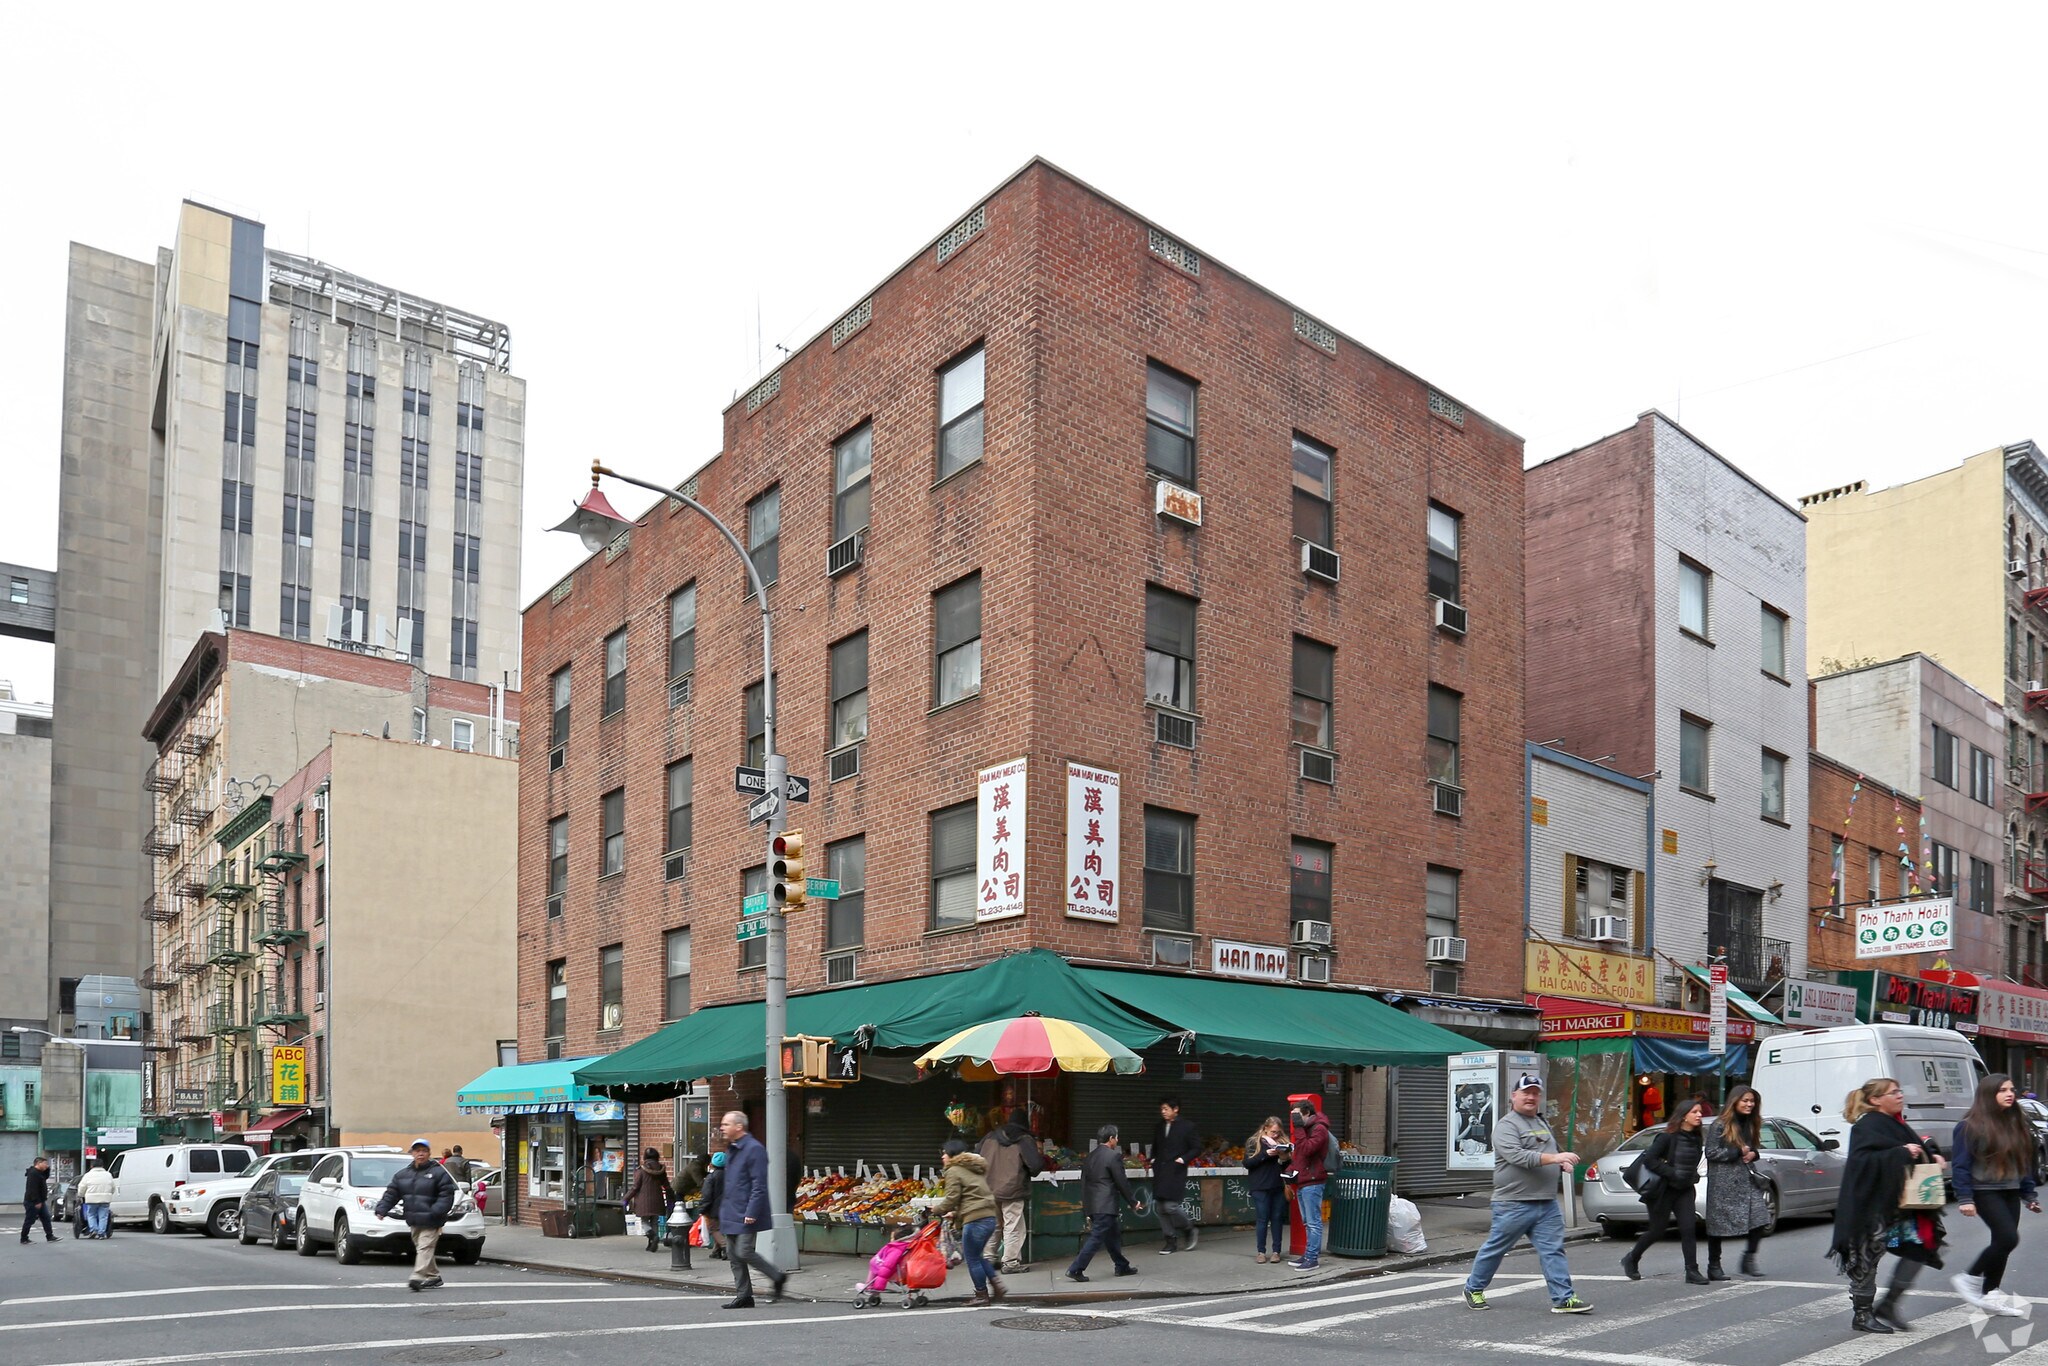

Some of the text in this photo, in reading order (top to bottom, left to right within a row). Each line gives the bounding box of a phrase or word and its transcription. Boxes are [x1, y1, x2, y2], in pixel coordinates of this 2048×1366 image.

[980, 774, 990, 784] HAN
[991, 771, 1002, 782] MAY
[1003, 765, 1017, 778] MEAT
[1069, 766, 1080, 777] HAN
[1081, 769, 1094, 781] MAY
[1095, 773, 1109, 784] MEAT
[746, 776, 801, 794] ONE AY
[806, 880, 828, 891] BERRY
[745, 895, 764, 908] BAYARD
[1884, 908, 1914, 924] Thanh
[1894, 941, 1926, 950] VIETNAMESE
[1927, 939, 1948, 947] CUISINE
[1220, 948, 1285, 974] HAN MAY
[1539, 976, 1558, 989] HAI
[1560, 979, 1587, 993] CANG
[1591, 982, 1609, 995] SEA
[1612, 985, 1636, 999] FOOD
[1804, 988, 1817, 1008] ASIA
[1818, 990, 1840, 1011] MARKET
[1914, 982, 1947, 1011] Thanh
[1540, 1015, 1623, 1032] ISH MARKET
[1692, 1020, 1701, 1031] HAI
[275, 1049, 303, 1061] ABC
[1461, 1056, 1485, 1064] TITAN
[1769, 1050, 1781, 1064] E
